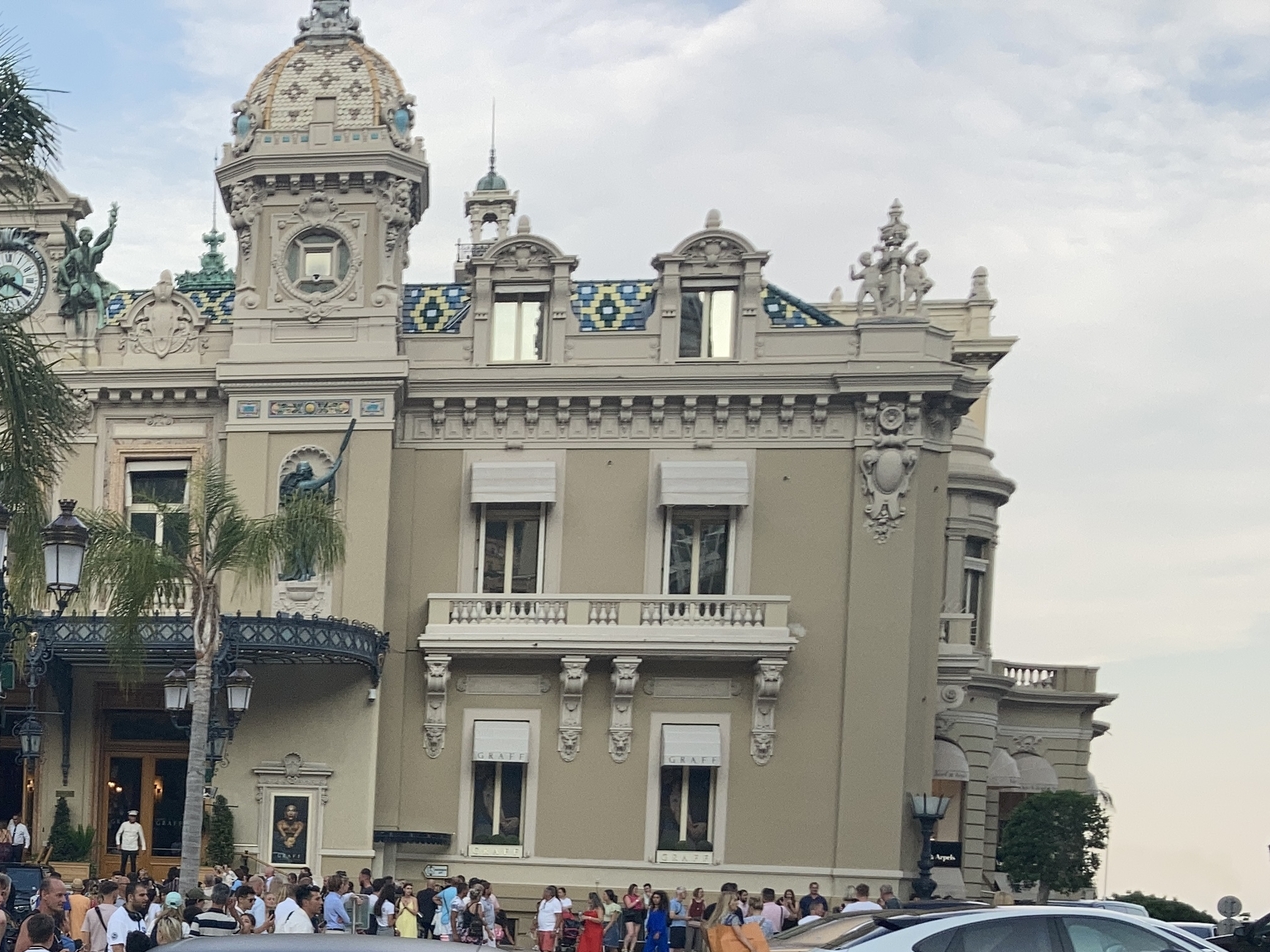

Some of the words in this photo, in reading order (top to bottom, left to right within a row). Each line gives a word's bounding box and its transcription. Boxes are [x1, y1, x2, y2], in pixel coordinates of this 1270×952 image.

[477, 751, 525, 761] GRAFF
[668, 755, 717, 764] GRAFF
[661, 853, 709, 862] GRAFF
